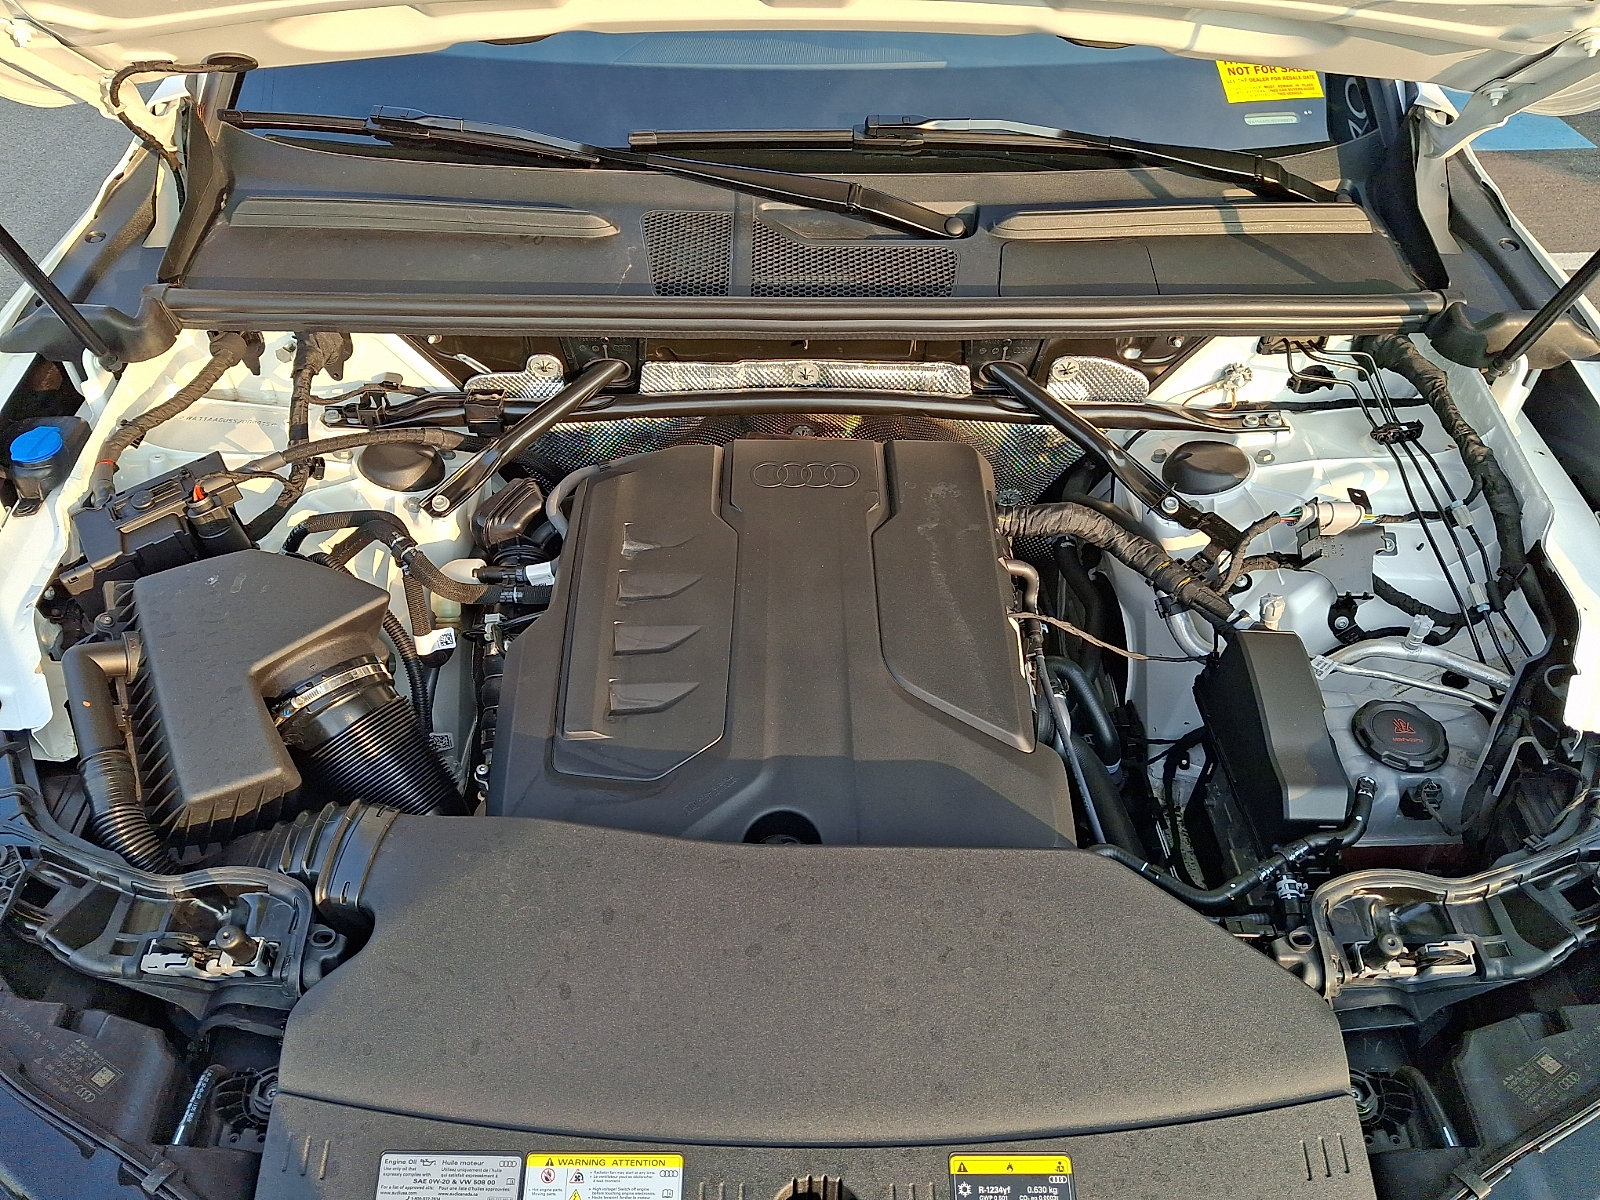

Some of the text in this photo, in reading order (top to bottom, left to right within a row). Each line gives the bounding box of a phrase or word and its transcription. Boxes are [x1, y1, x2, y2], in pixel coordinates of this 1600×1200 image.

[1227, 66, 1250, 76] NOT
[1254, 65, 1278, 74] FOR
[978, 1186, 1058, 1195] R-1234yf 0.630 kg
